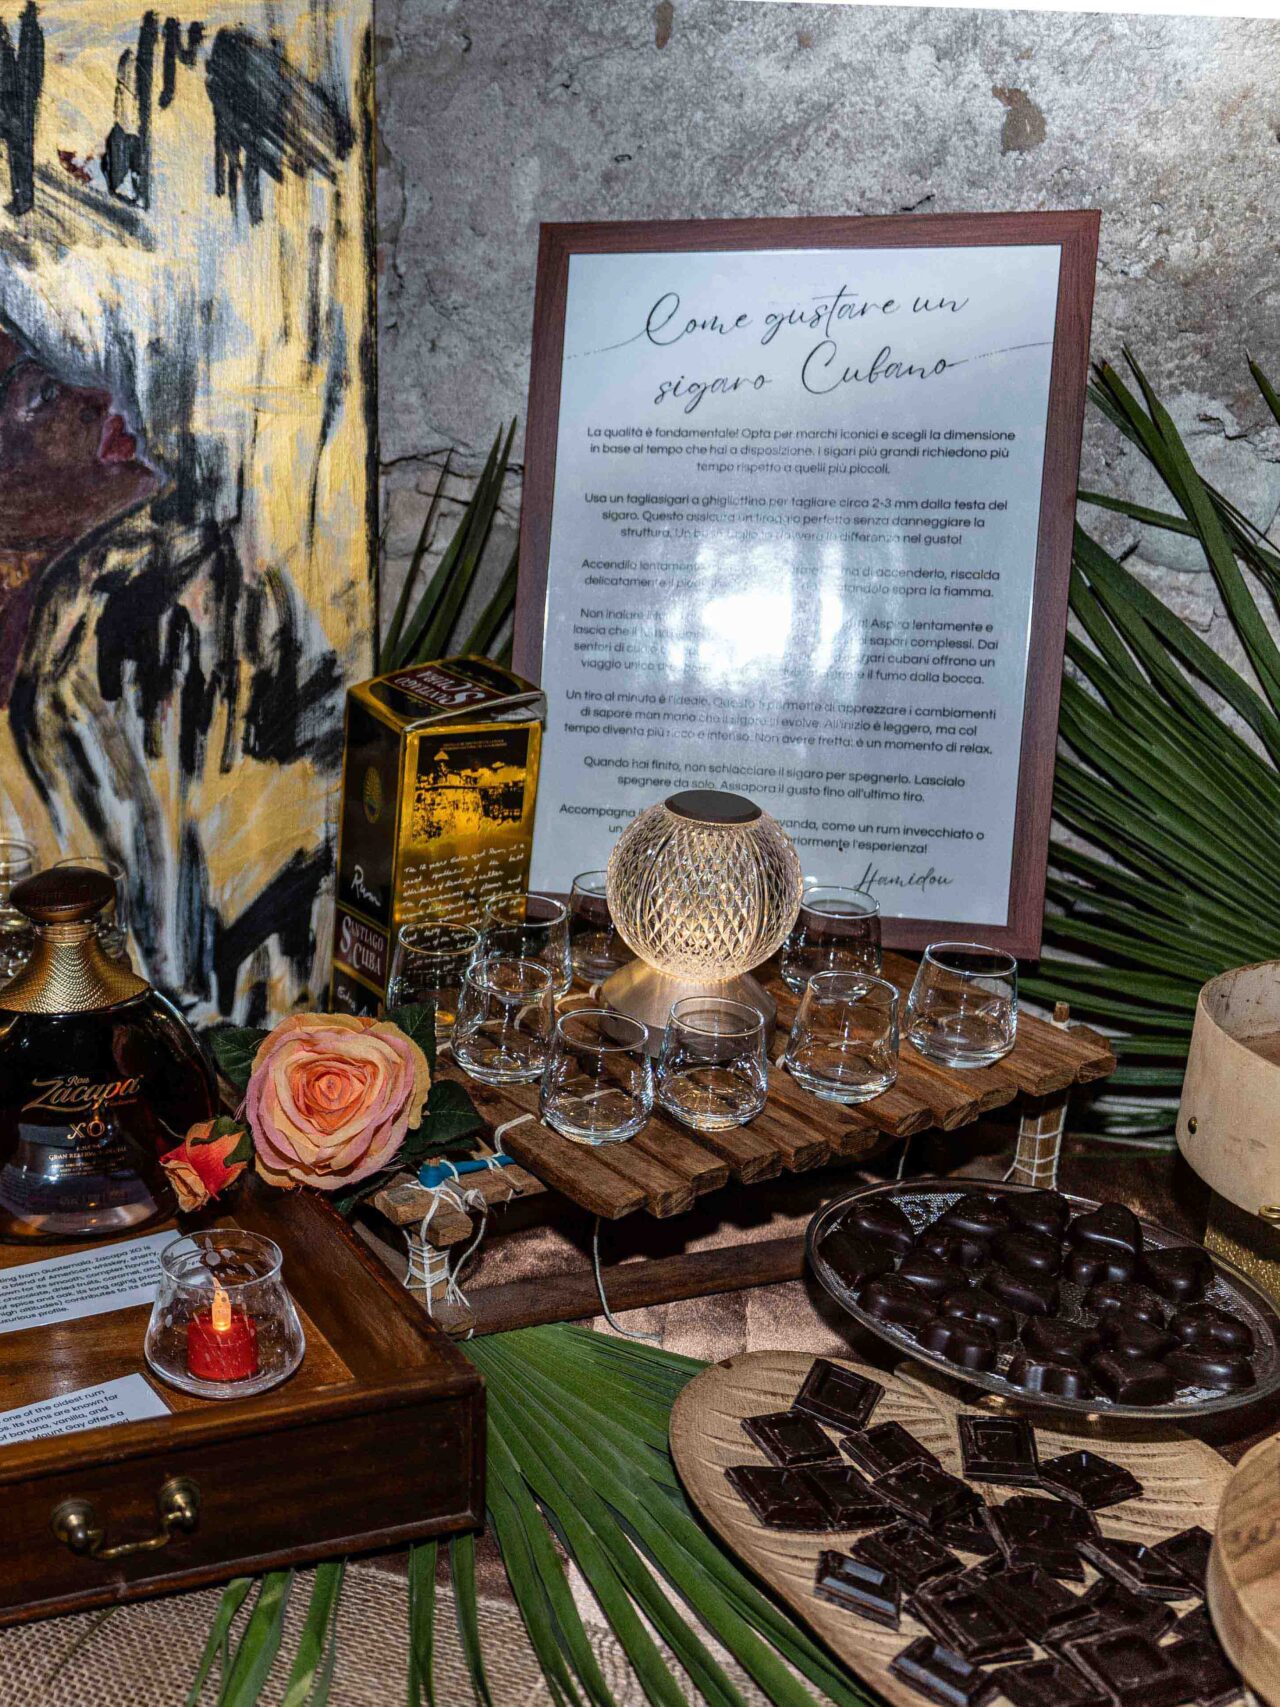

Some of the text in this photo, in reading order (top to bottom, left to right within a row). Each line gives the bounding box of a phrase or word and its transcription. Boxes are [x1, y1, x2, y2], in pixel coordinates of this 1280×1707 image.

[642, 284, 971, 346] Come gustare un
[653, 340, 970, 414] sigaro Cubano
[586, 426, 1016, 442] La qualità è fondamentale! Opta per marchi iconici e scegli la dimensione
[589, 443, 600, 453] in
[602, 443, 630, 453] base
[632, 444, 643, 453] al
[646, 444, 683, 456] tempo
[685, 444, 707, 454] che
[709, 444, 727, 454] hai
[739, 445, 814, 458] disposizione.
[822, 446, 856, 458] sigari
[858, 446, 877, 458] più
[879, 446, 919, 459] grandi
[921, 447, 987, 457] richiedono
[989, 448, 1009, 460] più
[696, 461, 890, 476] tempo rispetto a quelli più piccoli.
[583, 492, 607, 502] Usa
[608, 495, 623, 503] un
[626, 493, 688, 506] tagliasigari
[701, 495, 766, 508] ghigliottina
[767, 498, 788, 508] per
[791, 496, 836, 509] tagliare
[838, 497, 869, 507] circa
[871, 498, 891, 508] 2-3
[894, 500, 918, 508] mm
[920, 499, 951, 509] dalla
[954, 499, 985, 509] testa
[987, 500, 1007, 510] del
[601, 510, 639, 522] sigaro.
[641, 510, 683, 521] Questo
[685, 511, 735, 522] assicura
[801, 514, 850, 527] perfetto
[852, 517, 888, 525] senza
[890, 515, 970, 529] danneggiare
[972, 517, 985, 527] la
[394, 677, 487, 706] SANTIAGO
[416, 670, 474, 692] CUBA
[563, 722, 600, 736] tempo
[602, 724, 644, 736] diventa
[646, 726, 664, 739] più
[754, 732, 779, 743] Non
[781, 735, 816, 744] avere
[855, 737, 864, 747] è
[866, 740, 882, 748] un
[884, 738, 943, 751] momento
[945, 742, 957, 752] di
[959, 742, 993, 754] relax.
[582, 755, 965, 787] Quando hai finito, non schiacciare il sigaro per spegnerlo. Lascialo
[617, 776, 924, 801] spegnere Assapora il gusto fino all'ultimo tiro.
[351, 863, 382, 908] Rum
[340, 915, 384, 954] SANTIAGO
[352, 942, 382, 977] CUBA
[20, 1076, 143, 1113] Zacapa
[66, 1075, 91, 1087] Ron
[66, 1120, 106, 1141] XO
[2, 1413, 22, 1422] one
[23, 1409, 34, 1417] of
[35, 1405, 52, 1413] the
[53, 1396, 84, 1409] oldest
[84, 1390, 105, 1398] rum
[27, 1413, 53, 1424] rums
[53, 1408, 71, 1417] are
[71, 1399, 104, 1412] known
[104, 1394, 119, 1402] for
[9, 1422, 52, 1438] banana,
[51, 1412, 88, 1427] vanilla,
[88, 1405, 109, 1416] and
